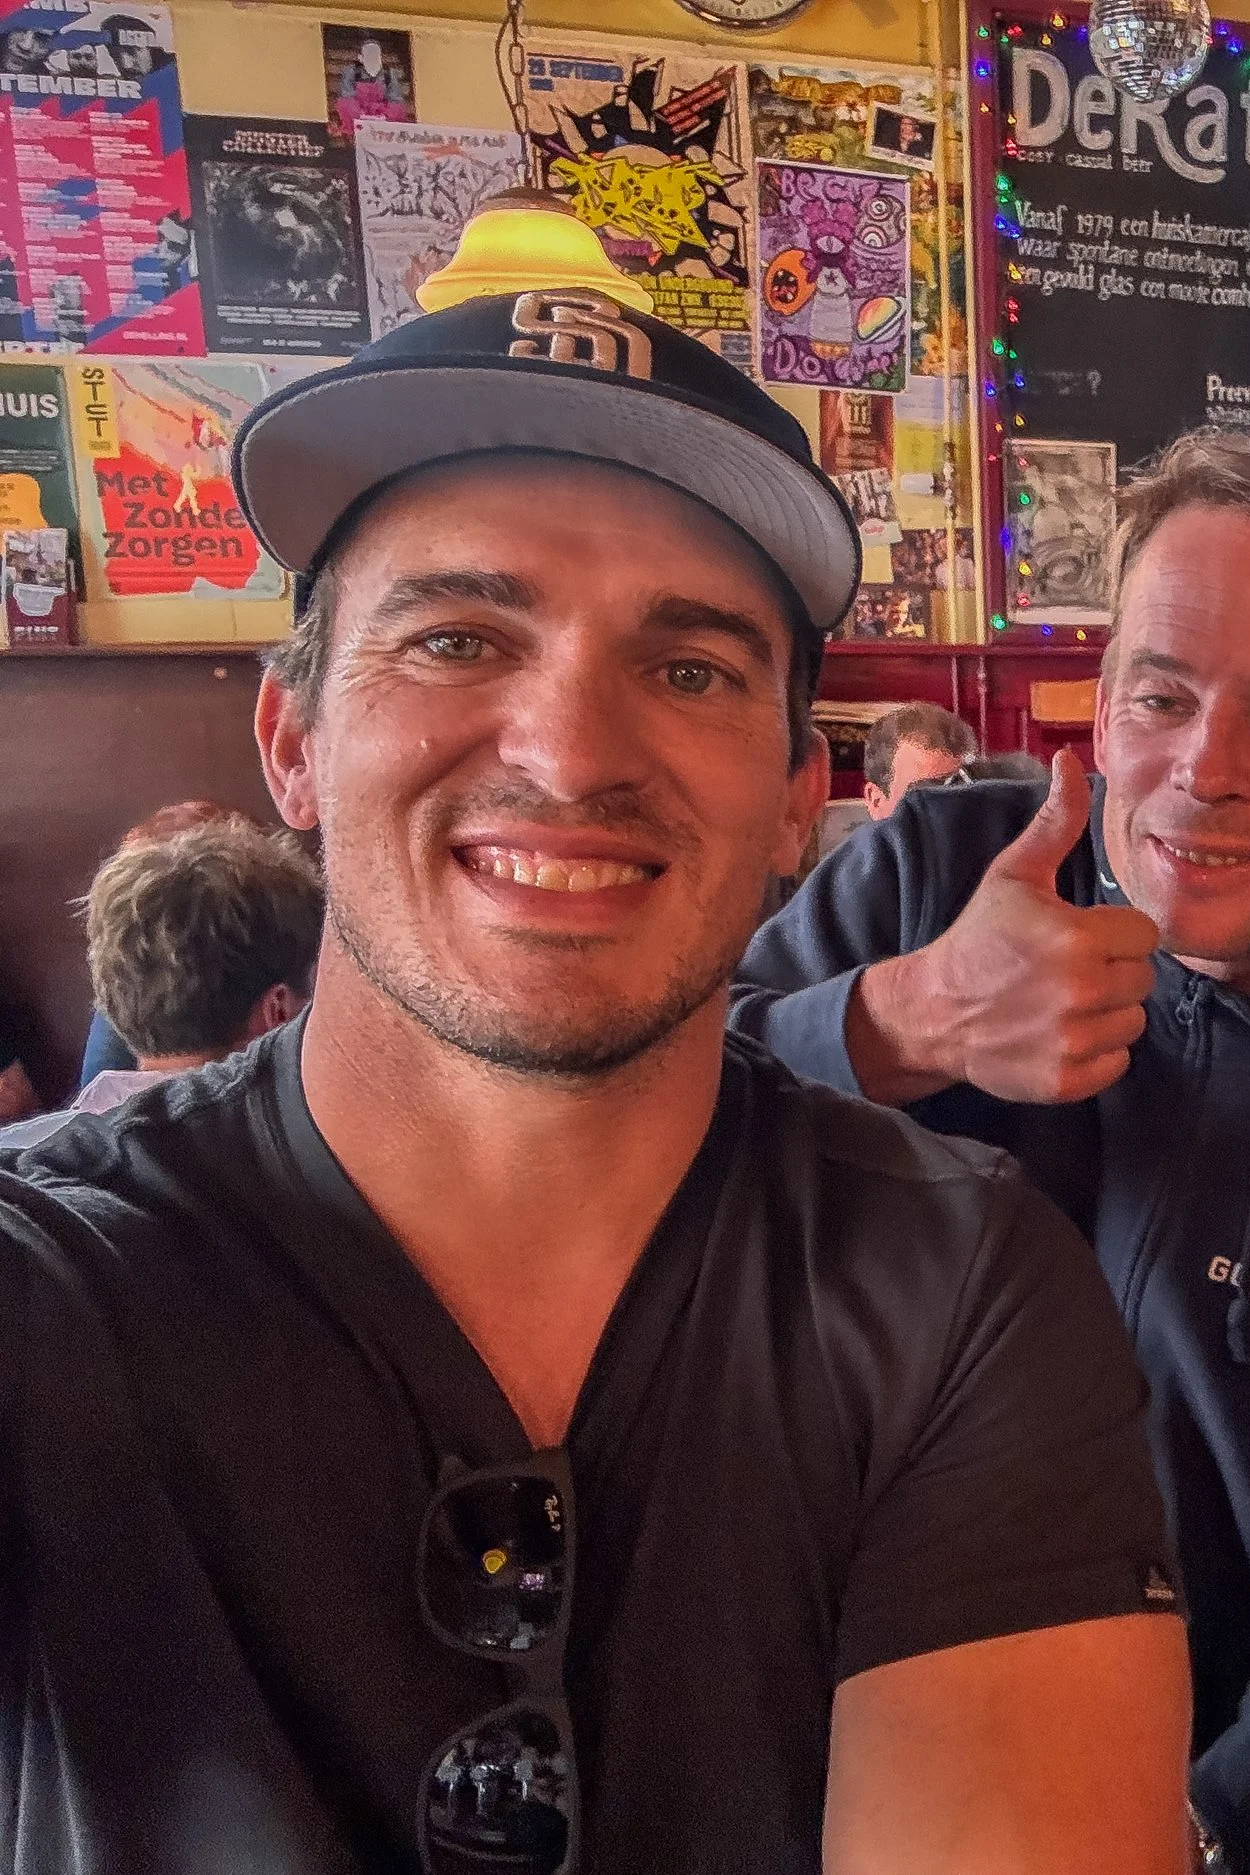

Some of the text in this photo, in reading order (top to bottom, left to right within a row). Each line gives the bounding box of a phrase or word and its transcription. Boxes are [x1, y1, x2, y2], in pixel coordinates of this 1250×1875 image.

[1015, 199, 1068, 236] Vanaf
[1120, 218, 1149, 237] een
[0, 393, 59, 418] UIS
[96, 471, 169, 497] Met
[103, 532, 243, 567] Zorgen
